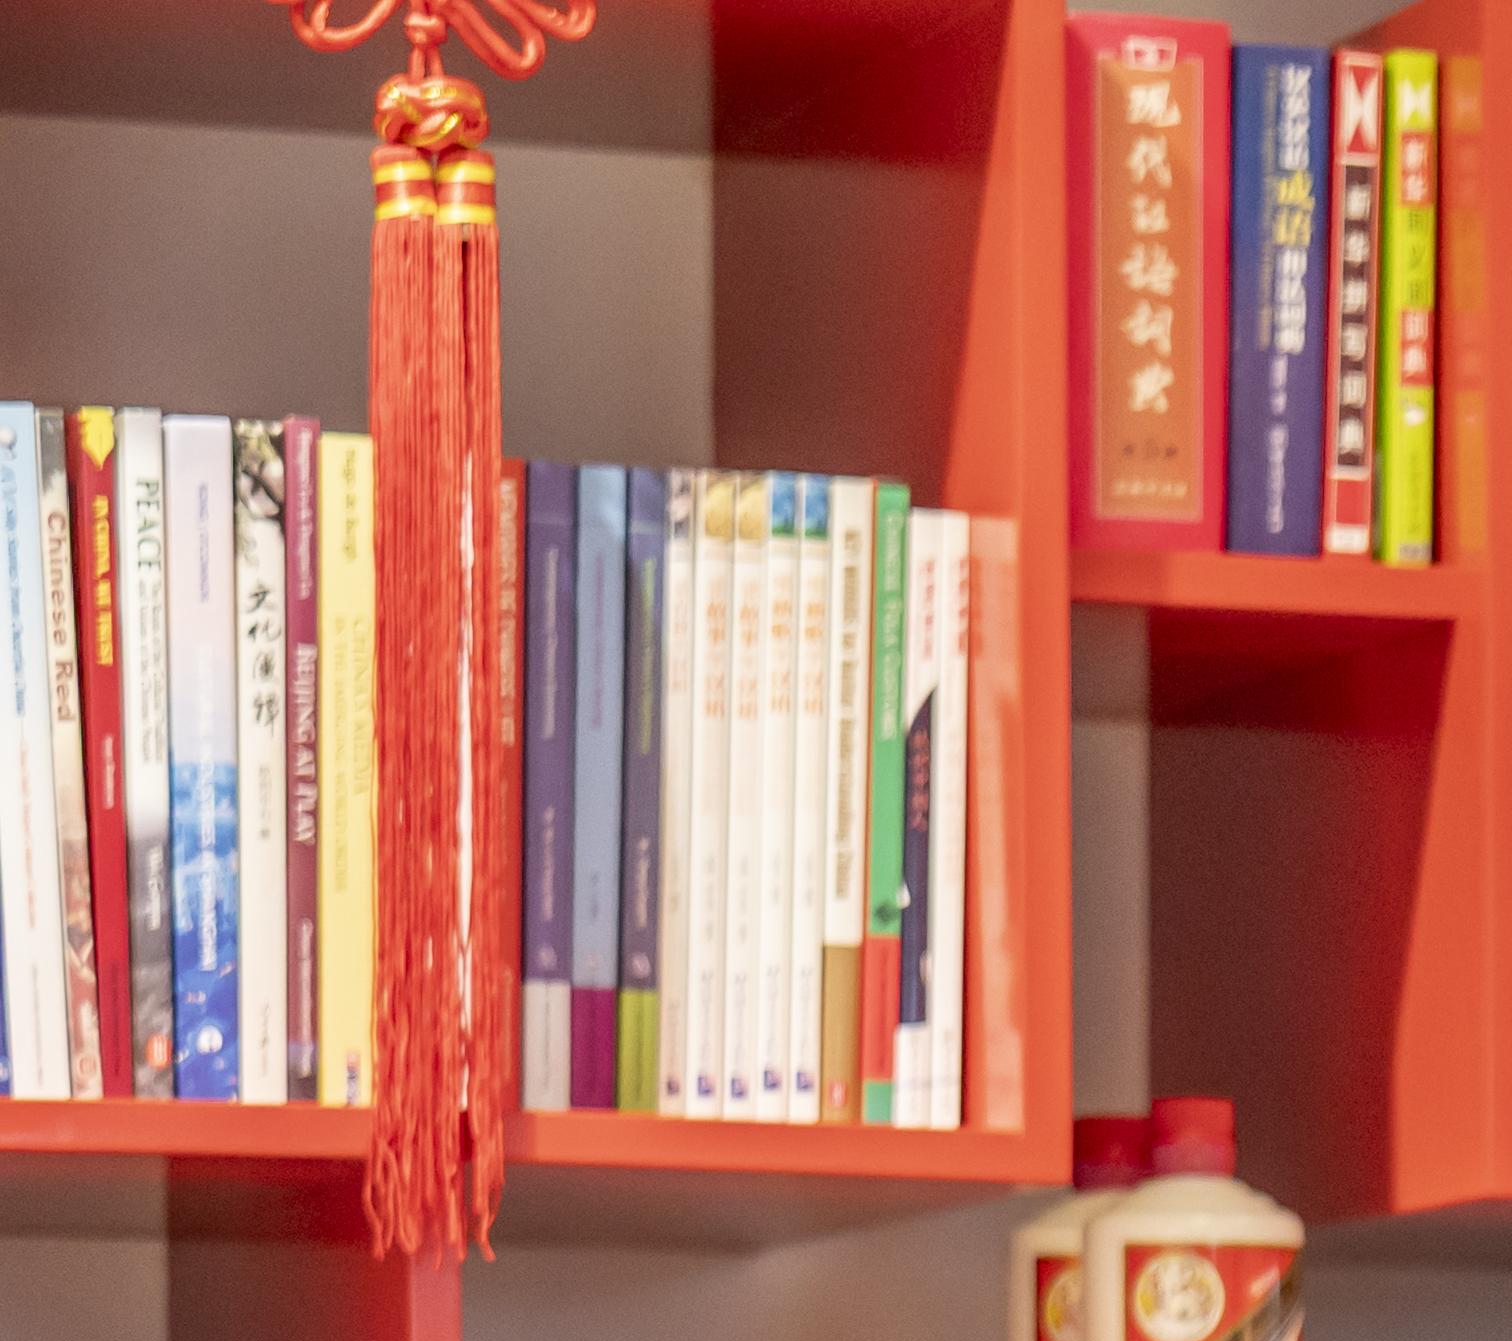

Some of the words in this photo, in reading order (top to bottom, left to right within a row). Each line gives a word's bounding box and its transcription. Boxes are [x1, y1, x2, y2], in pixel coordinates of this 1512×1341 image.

[1120, 80, 1181, 414] 现代汉语词典
[136, 479, 162, 572] PEACE
[47, 510, 69, 646] Chinese
[55, 658, 76, 723] Red
[292, 642, 319, 743] BEIJING
[294, 745, 316, 777] AT
[294, 782, 319, 846] PLAY
